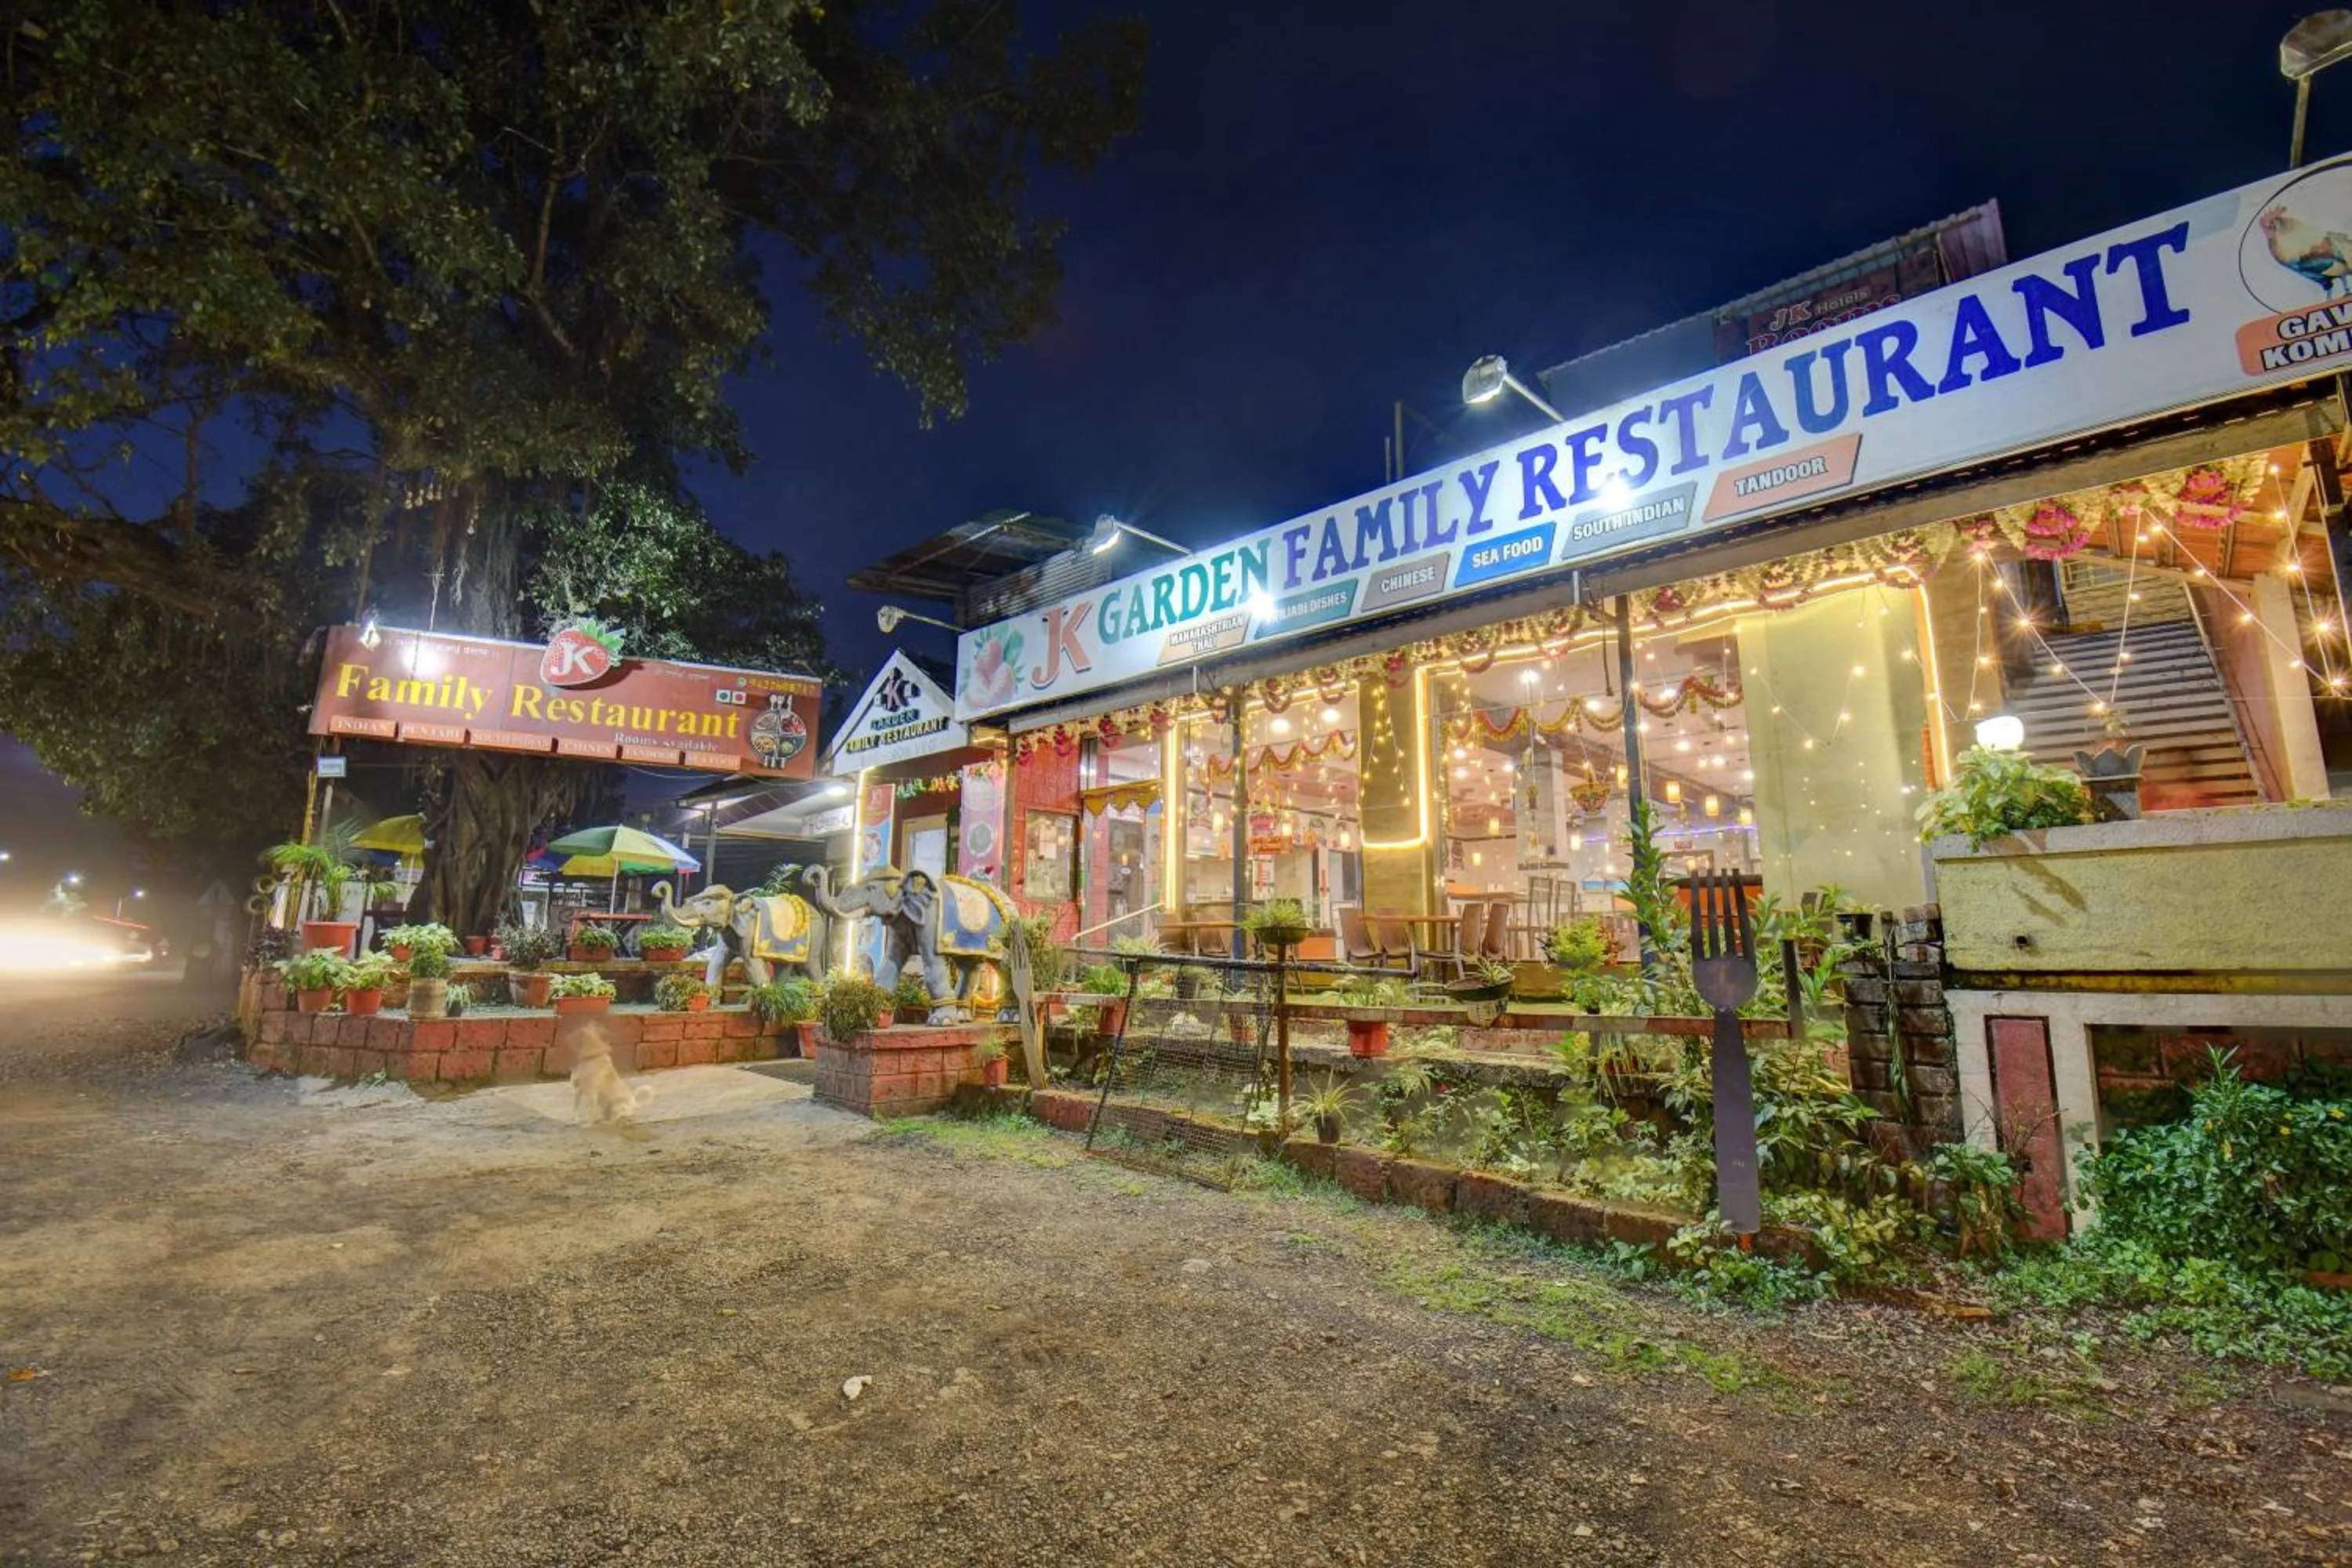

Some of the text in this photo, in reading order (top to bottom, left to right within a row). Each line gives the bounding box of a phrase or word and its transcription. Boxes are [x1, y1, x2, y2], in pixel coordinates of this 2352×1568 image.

[1769, 301, 1813, 332] JK
[1816, 287, 1871, 314] Hotels
[1030, 601, 1094, 690] JK
[1100, 540, 1271, 644] GARDEN
[1283, 459, 1499, 590] FAMILY
[1516, 220, 2190, 520] RESTAURANT
[1735, 456, 1828, 497] TANDOOR
[1573, 495, 1685, 541] SOUTH INDIAN
[1472, 535, 1543, 568] SEA FOOD
[1381, 564, 1436, 593] CHINESE
[1309, 590, 1348, 612] DISHES
[550, 638, 594, 676] JK
[336, 663, 741, 739] Family Restaurant
[614, 731, 658, 746] Rooms
